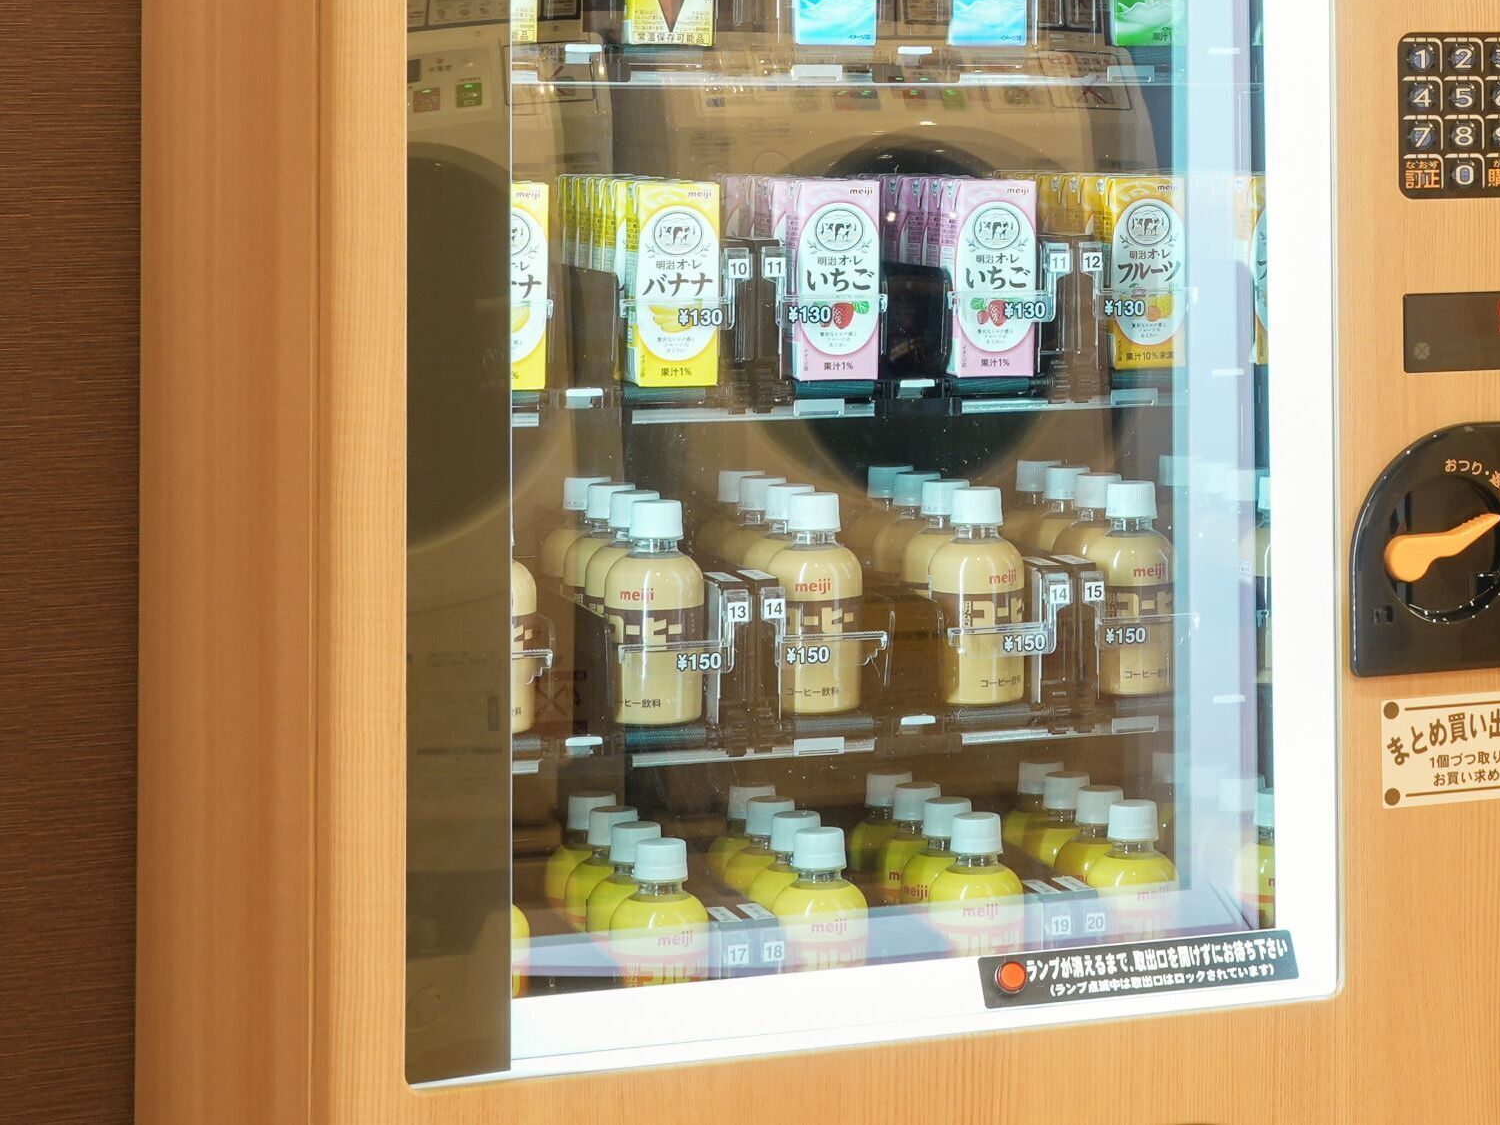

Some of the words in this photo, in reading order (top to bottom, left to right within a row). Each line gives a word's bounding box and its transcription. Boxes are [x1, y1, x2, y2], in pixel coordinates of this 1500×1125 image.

[1415, 49, 1426, 69] 1
[1455, 48, 1472, 68] 2
[1413, 87, 1431, 107] 4
[1455, 88, 1473, 108] 5
[1413, 127, 1431, 147] 7
[1454, 126, 1473, 146] 8
[1405, 169, 1440, 189] 訂正
[1455, 165, 1474, 185] 0
[515, 191, 541, 199] meiji
[688, 190, 712, 199] meiji
[849, 187, 873, 196] meiji
[1007, 186, 1030, 195] meiji
[731, 262, 747, 275] 10
[767, 262, 782, 274] 11
[1052, 256, 1067, 269] 11
[1084, 256, 1100, 269] 12
[807, 268, 875, 292] いちご
[965, 266, 1031, 290] いちご
[1117, 261, 1182, 284] フルーツ
[642, 272, 714, 296] バナナ
[788, 306, 831, 324] ¥130
[1004, 302, 1046, 319] ¥130
[1104, 300, 1145, 316] ¥130
[677, 309, 723, 326] ¥130
[824, 362, 854, 370] 果汁1%
[981, 358, 1010, 367] 果汁1%
[661, 367, 692, 377] 果汁1%
[989, 569, 1017, 586] meiji
[1133, 564, 1165, 579] meiji
[795, 578, 831, 594] meiji
[1087, 585, 1102, 598] 15
[1051, 588, 1067, 601] 14
[729, 605, 746, 618] 13
[766, 603, 782, 616] 14
[1003, 635, 1046, 652] ¥150
[1105, 627, 1146, 645] ¥150
[677, 653, 722, 671] ¥150
[786, 646, 830, 664] ¥150
[904, 885, 928, 900] meiji
[963, 903, 999, 919] meiji
[811, 919, 847, 935] meiji
[1053, 919, 1069, 932] 19
[1088, 916, 1104, 929] 20
[658, 930, 694, 947] meiji
[729, 948, 746, 962] 17
[765, 945, 783, 958] 18
